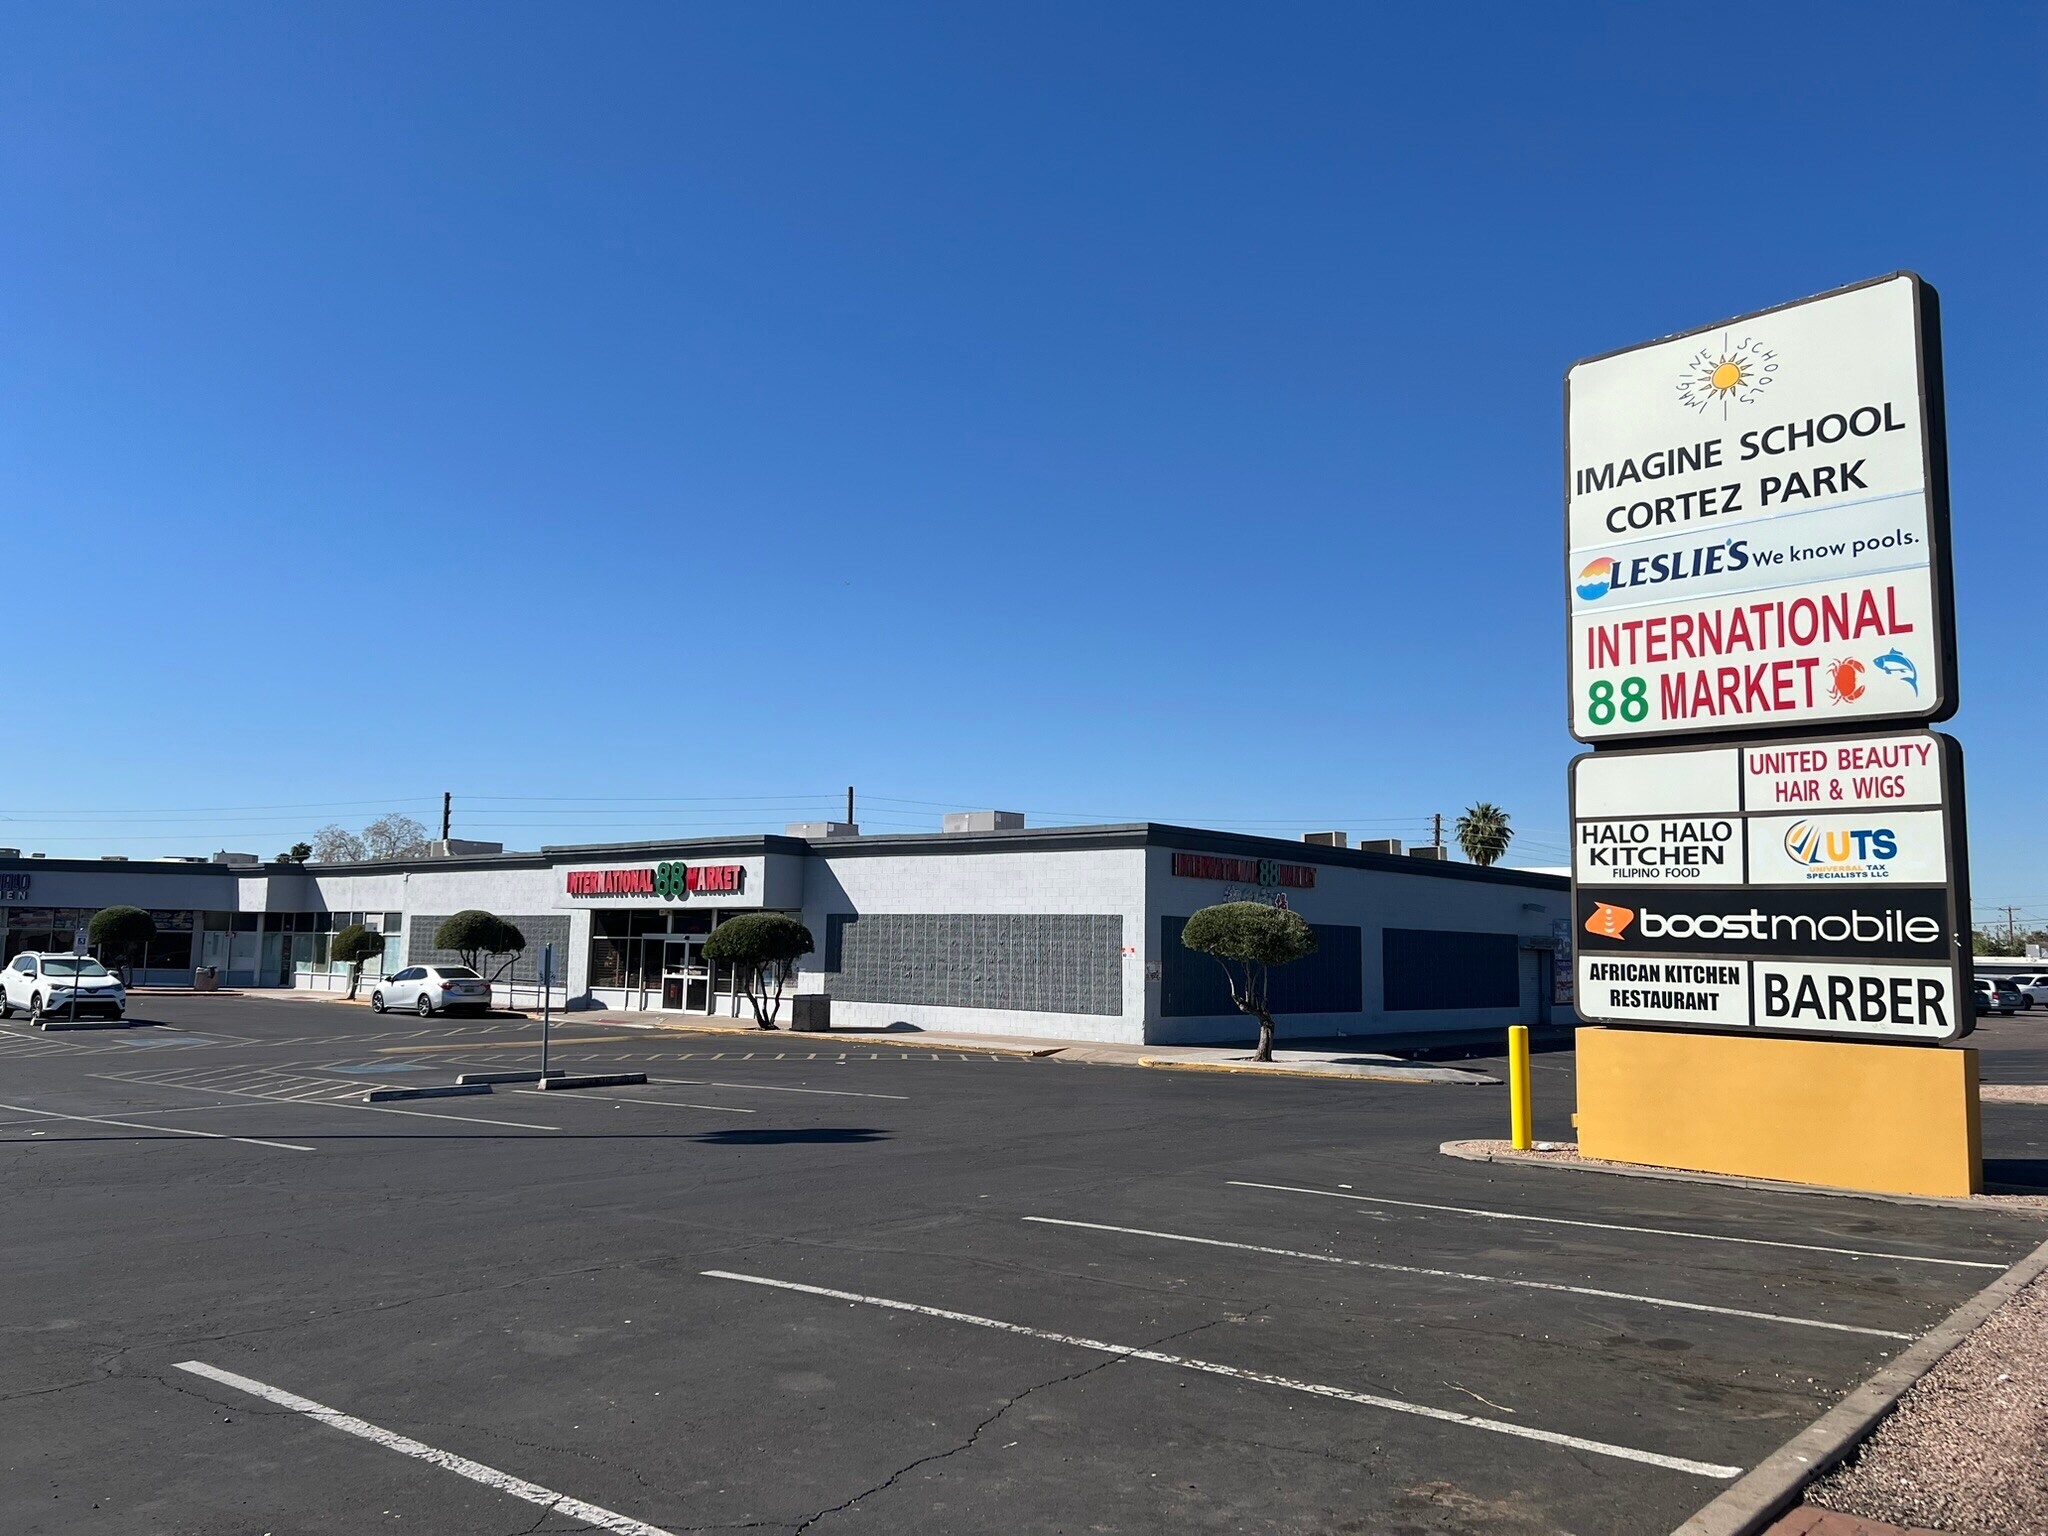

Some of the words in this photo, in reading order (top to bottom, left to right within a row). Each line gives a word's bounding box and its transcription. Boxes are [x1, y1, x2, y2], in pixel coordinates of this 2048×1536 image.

[1676, 348, 1712, 414] IMAGINE
[1737, 337, 1779, 404] SCHOOLS
[1576, 438, 1723, 496] IMAGINE
[1740, 402, 1906, 461] SCHOOL
[1605, 483, 1743, 534] CORTEZ
[1760, 459, 1868, 506] PARK
[1609, 539, 1750, 590] LESLIE'S
[1753, 548, 1784, 567] We
[1789, 542, 1847, 563] know
[1851, 529, 1920, 558] pools.
[1587, 586, 1914, 670] INTERNATIONAL
[1588, 676, 1649, 725] 88
[1660, 657, 1819, 720] MARKET
[1749, 749, 1828, 775] UNITED
[1837, 743, 1933, 770] BEAUTY
[1775, 780, 1821, 802] HAIR
[1829, 779, 1843, 800] &
[1853, 775, 1906, 799] WIGS
[1582, 823, 1649, 845] HALO
[1660, 821, 1733, 843] HALO
[1826, 829, 1898, 862] UTS
[1589, 845, 1725, 866] KITCHEN
[1809, 865, 1863, 873] UNIVERSAL
[566, 868, 654, 894] INTERNATIONAL
[655, 861, 687, 896] 88
[686, 865, 743, 891] MARKET
[1257, 858, 1280, 887] 88
[1612, 868, 1660, 878] FILIPINO
[1665, 868, 1701, 878] FOOD
[1589, 962, 1662, 983] AFRICAN
[1664, 965, 1741, 986] KITCHEN
[1609, 989, 1719, 1011] RESTAURANT
[1764, 972, 1948, 1027] BARBER
